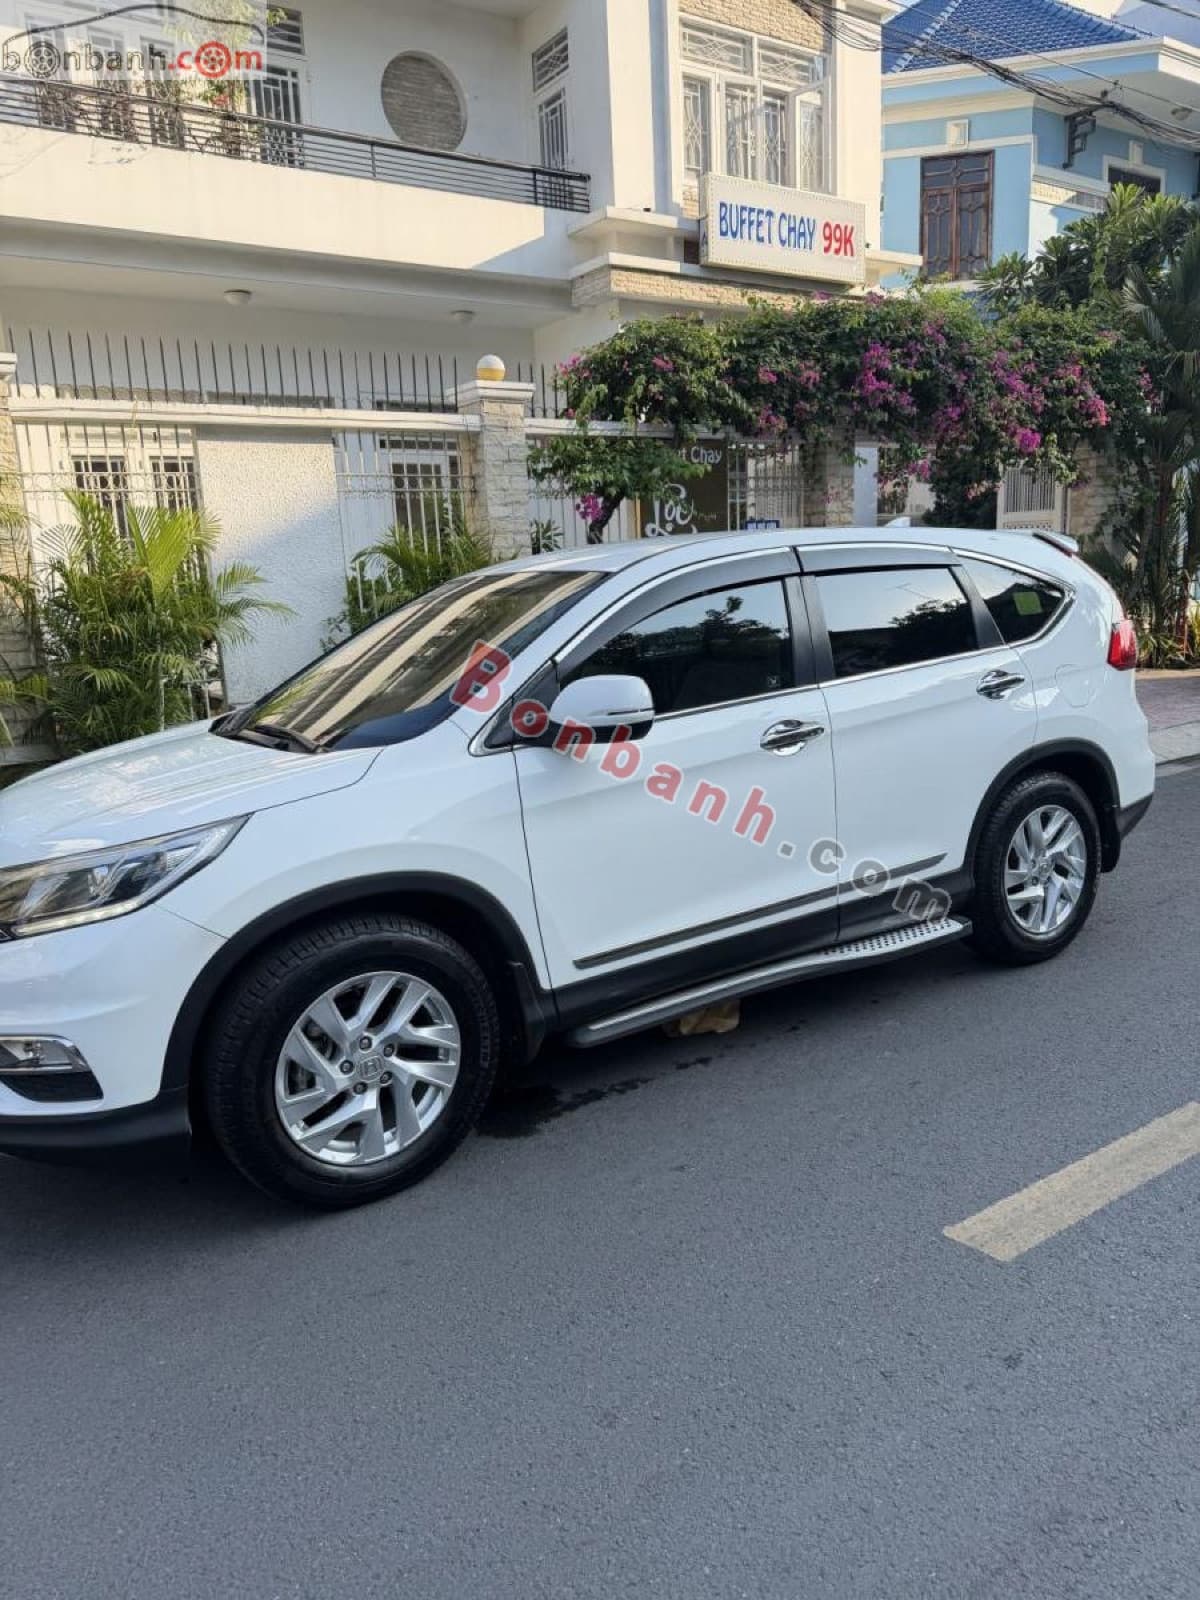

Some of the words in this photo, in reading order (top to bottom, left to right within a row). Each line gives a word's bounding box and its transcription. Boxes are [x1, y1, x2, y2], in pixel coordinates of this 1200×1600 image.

[719, 202, 775, 245] BUFFET
[778, 212, 816, 251] CHAY
[823, 221, 855, 257] 99K
[690, 446, 722, 465] Chay
